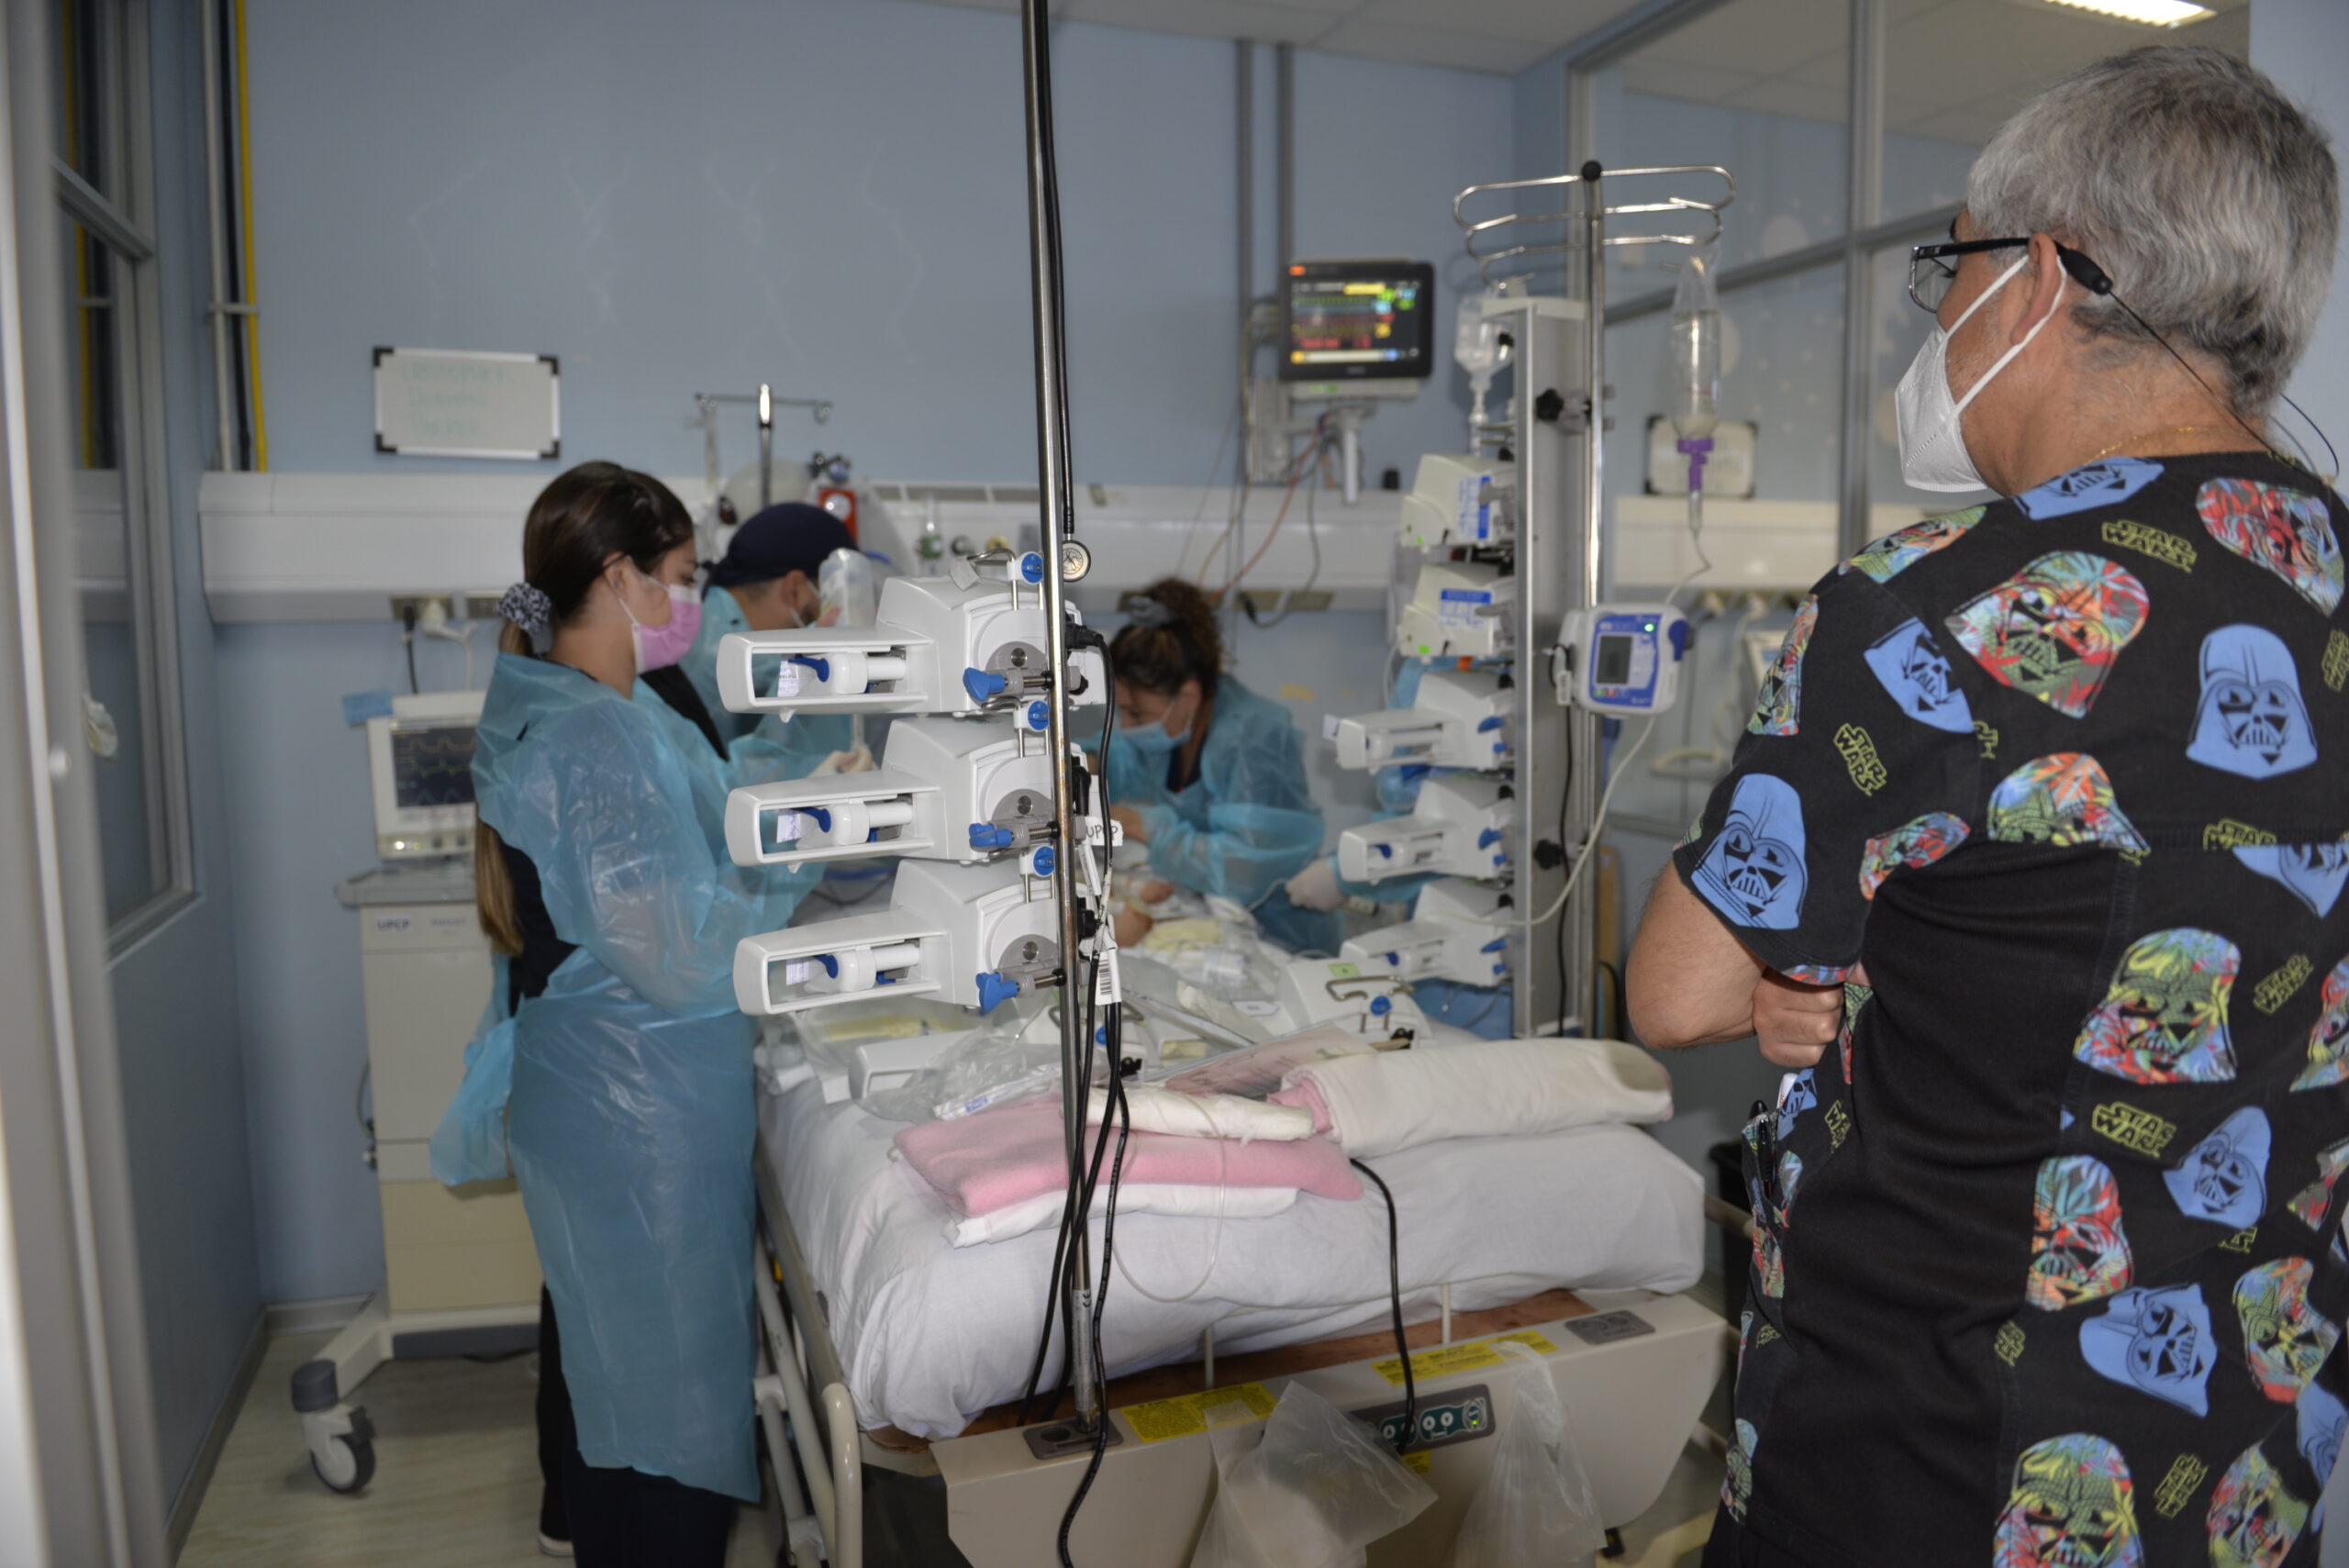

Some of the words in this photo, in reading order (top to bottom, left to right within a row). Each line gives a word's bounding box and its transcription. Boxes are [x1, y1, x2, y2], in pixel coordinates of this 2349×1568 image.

[2101, 528, 2194, 569] WARS
[2104, 519, 2197, 561] STAR
[1833, 725, 1879, 790] WARS
[1844, 723, 1887, 786] STAR
[1086, 824, 1119, 840] UPP
